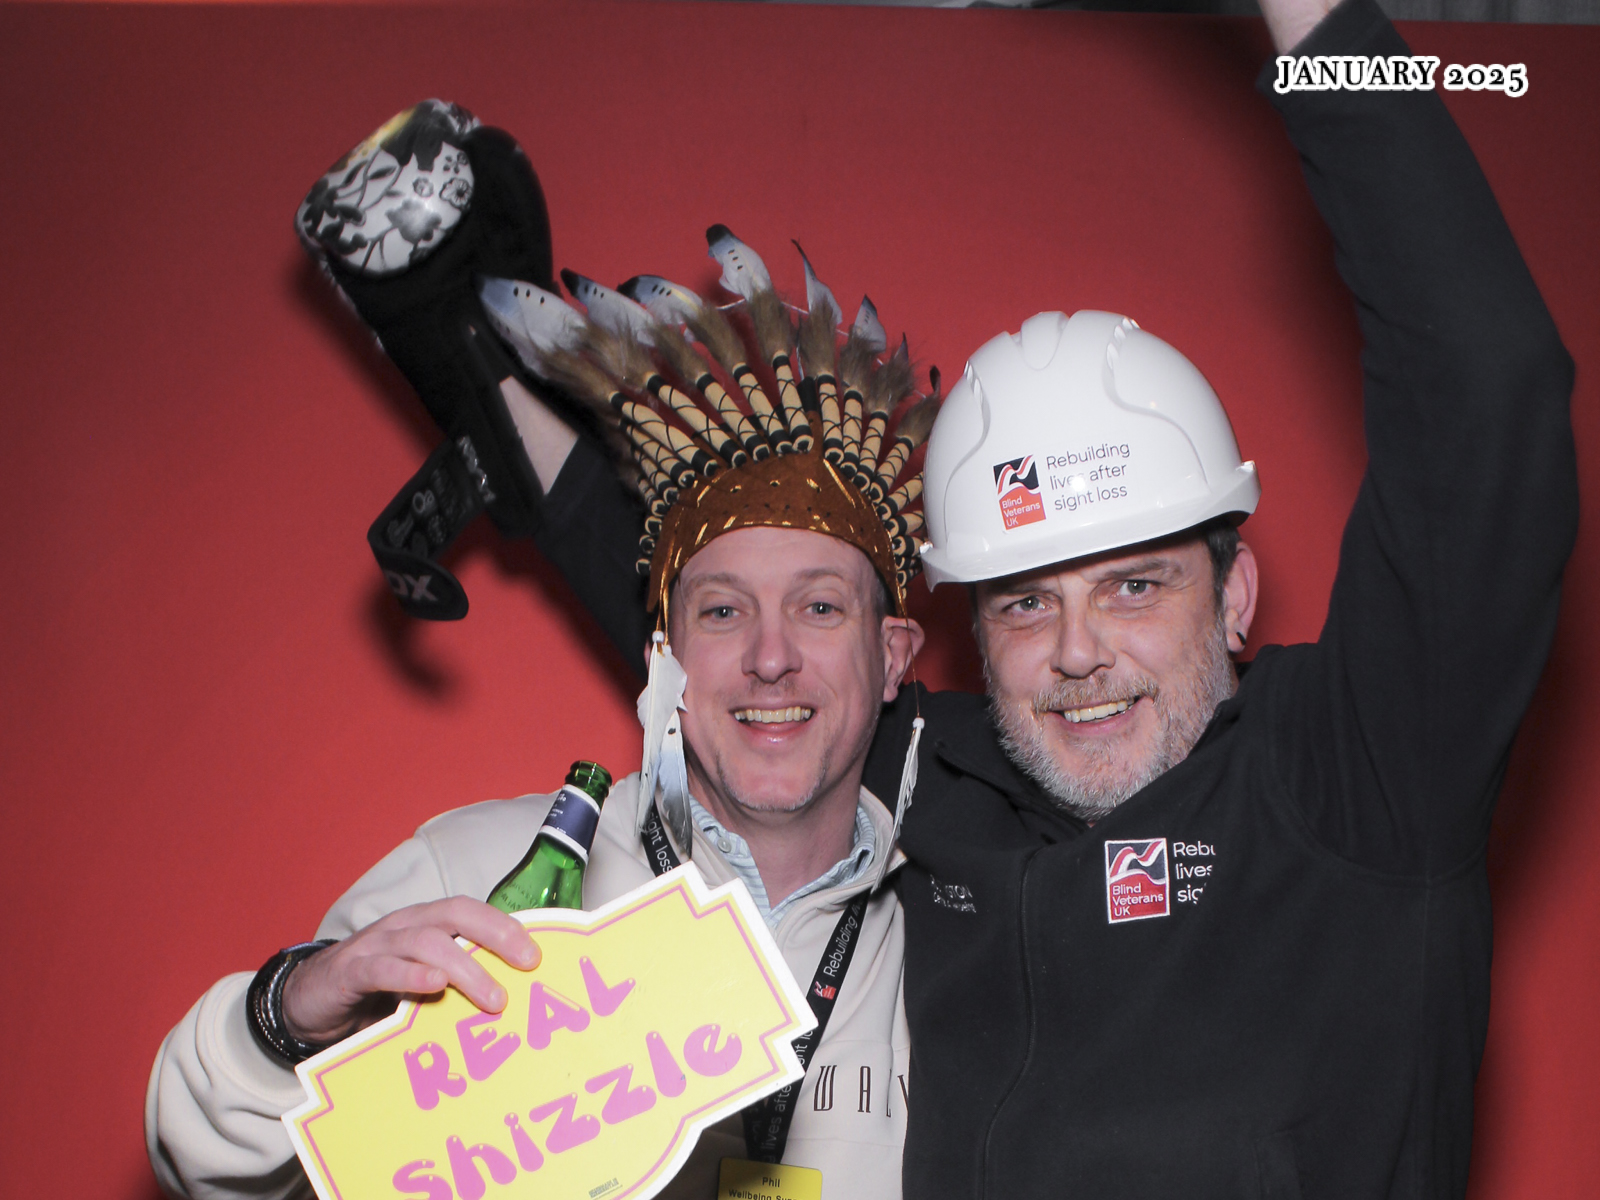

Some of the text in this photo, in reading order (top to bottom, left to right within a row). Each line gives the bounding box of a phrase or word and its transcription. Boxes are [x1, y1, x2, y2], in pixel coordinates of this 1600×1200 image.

[1046, 443, 1131, 470] Rebuilding
[1089, 464, 1127, 482] after
[1001, 495, 1023, 509] Blind
[1054, 485, 1128, 512] sight loss
[1003, 501, 1041, 518] Veterans
[1006, 517, 1019, 527] UK
[1112, 883, 1142, 896] Blind
[1112, 893, 1164, 907] Veterans
[1114, 906, 1131, 917] UK
[823, 916, 857, 978] Rebuilding
[403, 955, 637, 1111] REAL
[762, 1177, 781, 1188] Phil
